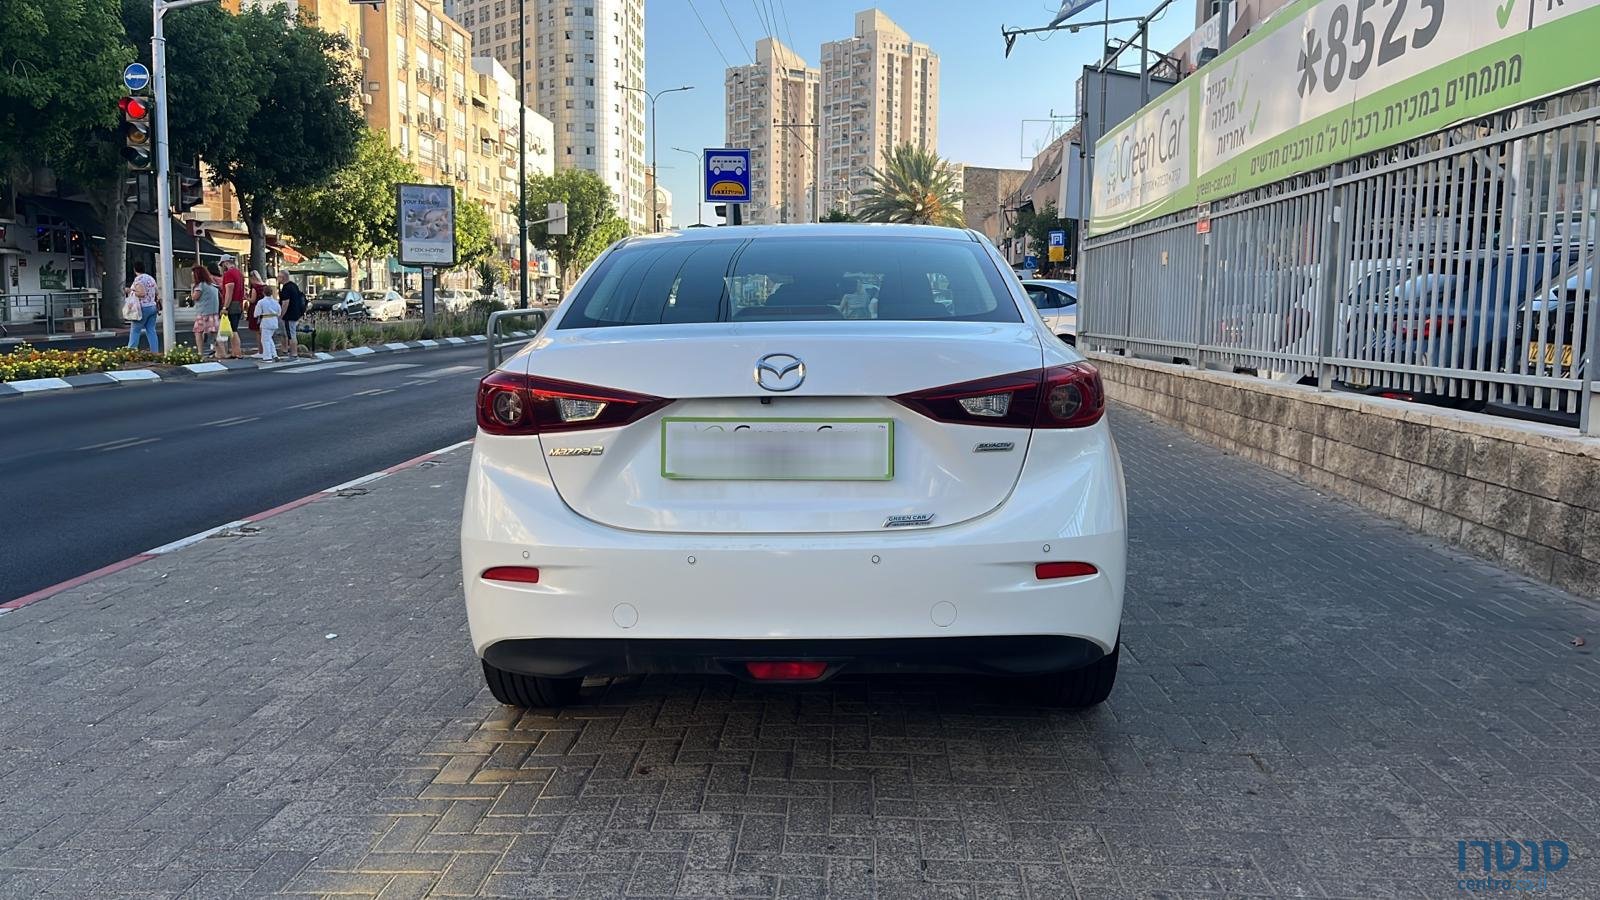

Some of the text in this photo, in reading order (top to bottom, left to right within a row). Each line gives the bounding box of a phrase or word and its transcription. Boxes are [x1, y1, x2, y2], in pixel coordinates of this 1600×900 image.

[1206, 77, 1227, 106] קנייה
[1445, 54, 1522, 108] מתמחים
[1211, 101, 1236, 131] מכירה
[1382, 87, 1440, 131] במכירת
[1120, 108, 1185, 183] Green Car
[1216, 125, 1246, 156] אחריות
[1281, 135, 1314, 164] ורכבים
[1250, 148, 1280, 176] חדשים
